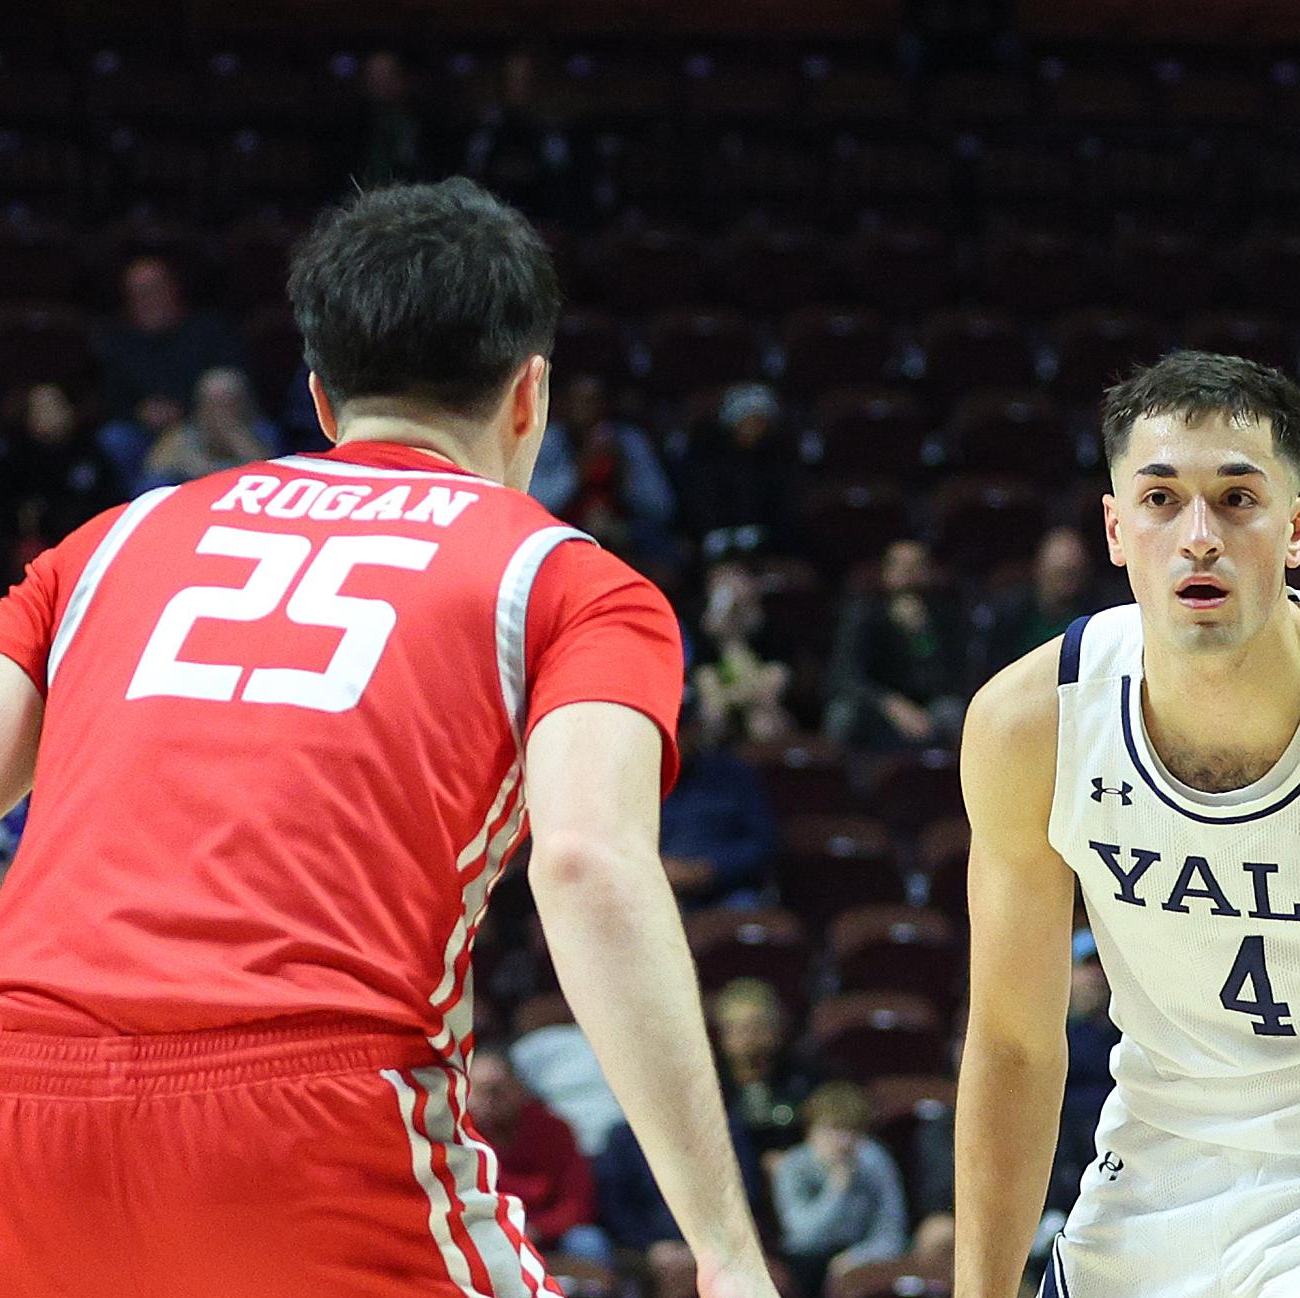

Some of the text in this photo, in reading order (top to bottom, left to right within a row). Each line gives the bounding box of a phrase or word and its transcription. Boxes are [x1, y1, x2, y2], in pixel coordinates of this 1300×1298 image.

[211, 475, 479, 527] ROGAN
[125, 525, 440, 714] 25
[1219, 935, 1297, 1037] 4
